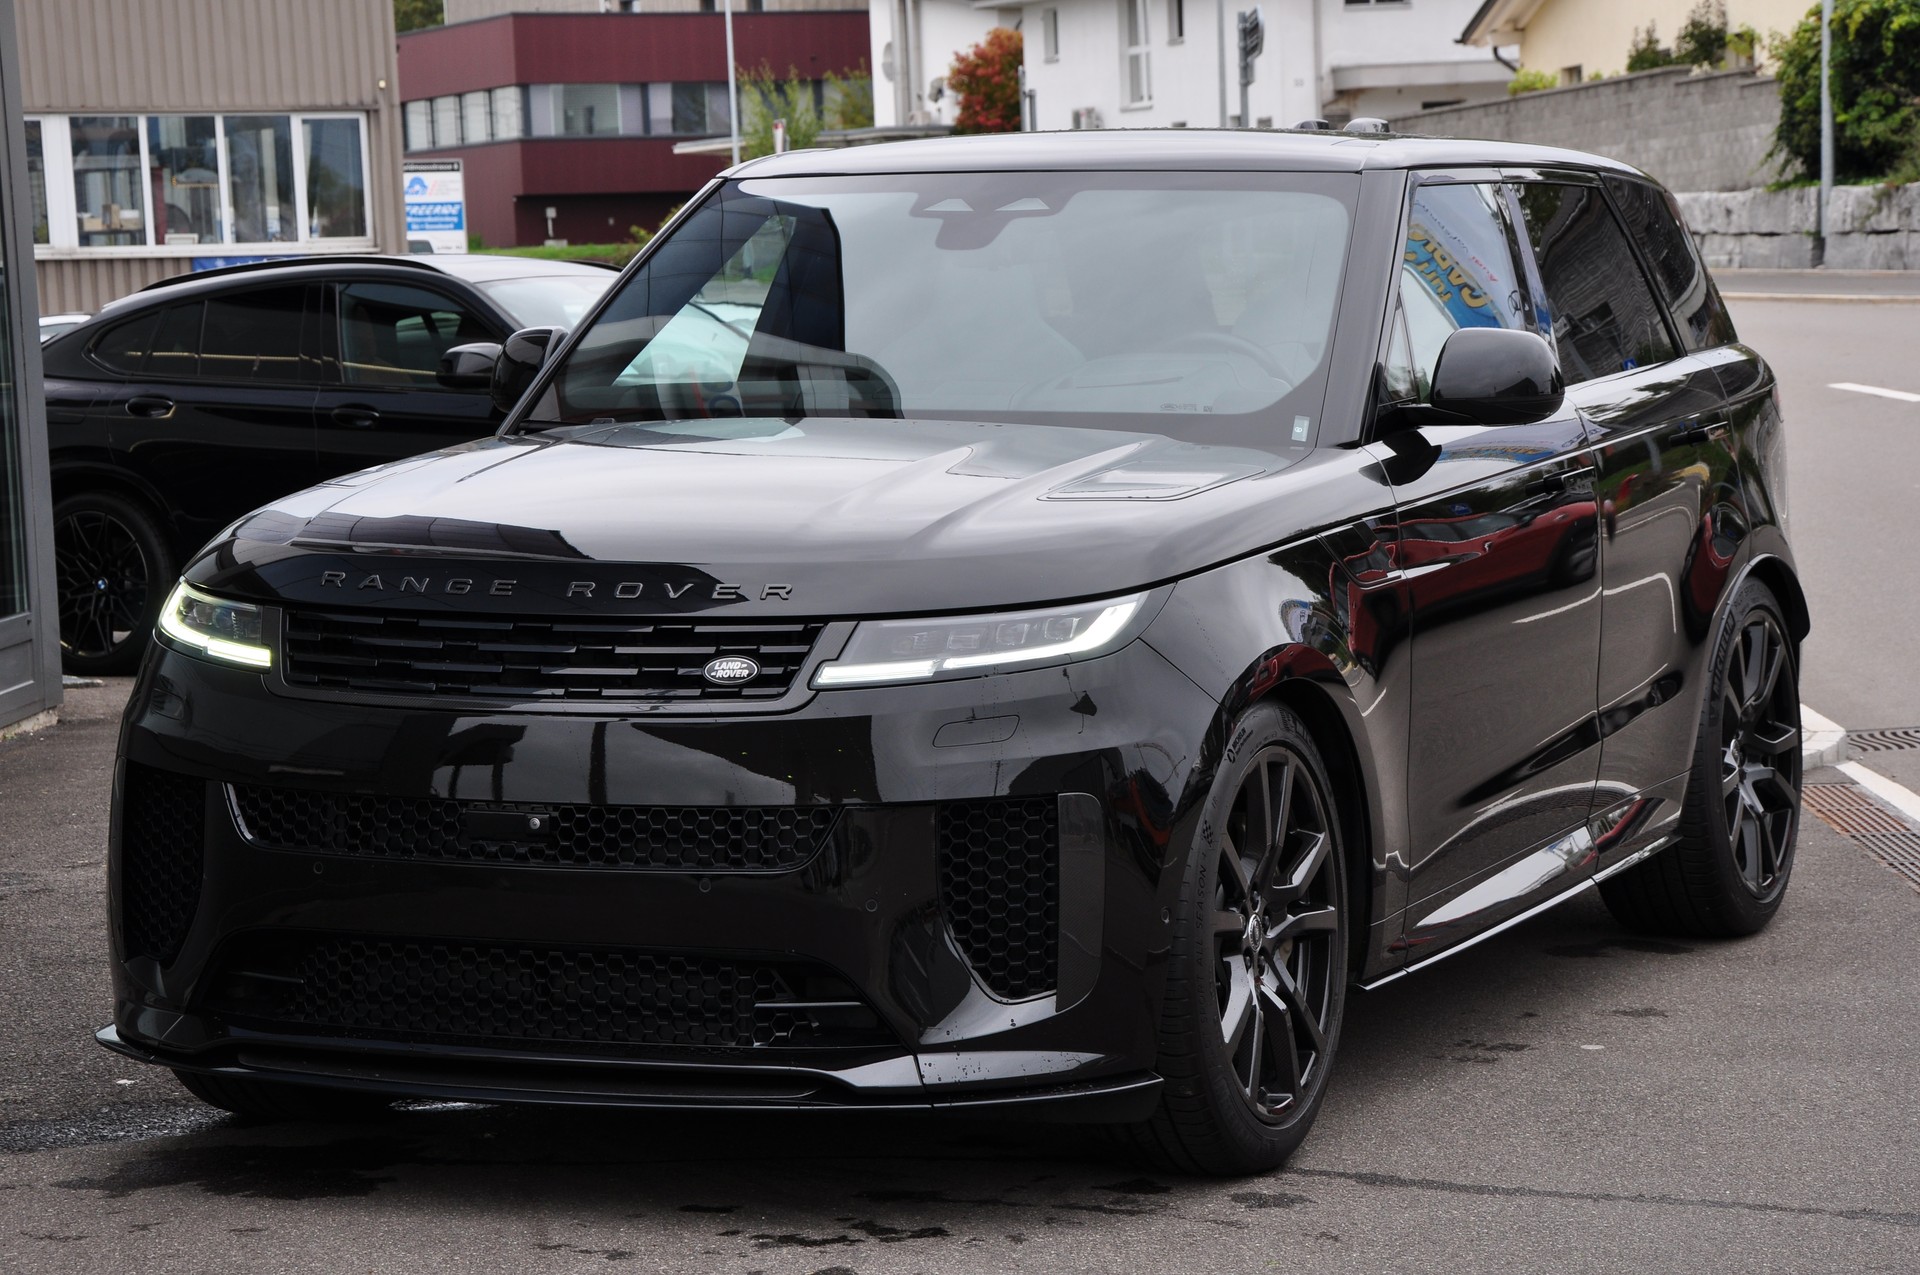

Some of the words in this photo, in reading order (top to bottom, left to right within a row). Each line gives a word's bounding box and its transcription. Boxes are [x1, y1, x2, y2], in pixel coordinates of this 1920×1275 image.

[320, 571, 517, 596] RANGE
[566, 581, 793, 600] ROVER
[714, 662, 741, 670] LAND
[716, 670, 749, 678] ROVER
[1196, 864, 1207, 930] SEASON
